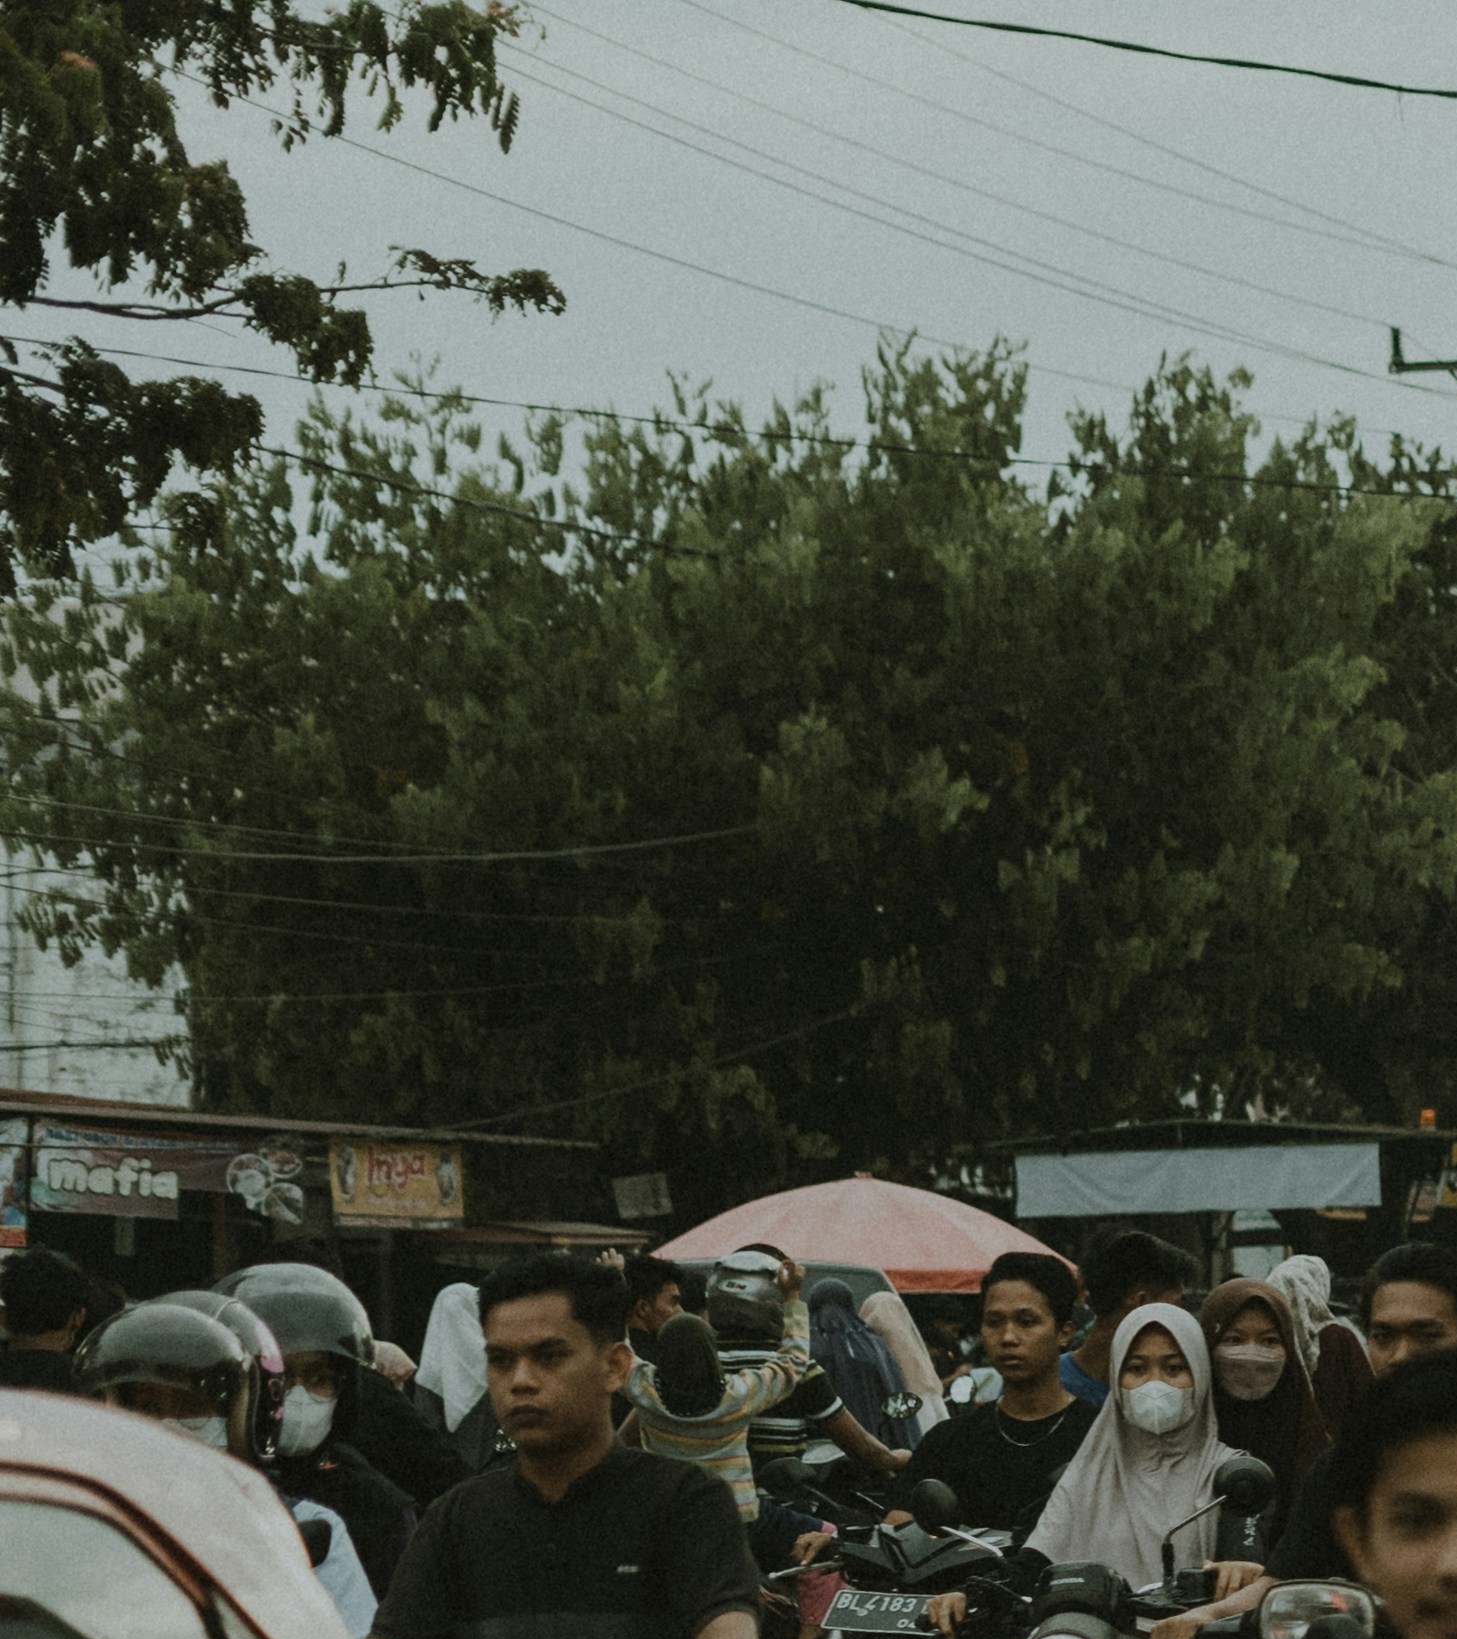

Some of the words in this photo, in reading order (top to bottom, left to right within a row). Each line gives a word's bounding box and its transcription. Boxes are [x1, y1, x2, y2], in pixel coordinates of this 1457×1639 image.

[49, 1157, 178, 1199] mafia
[836, 1593, 860, 1611] BL
[864, 1595, 918, 1613] 4183
